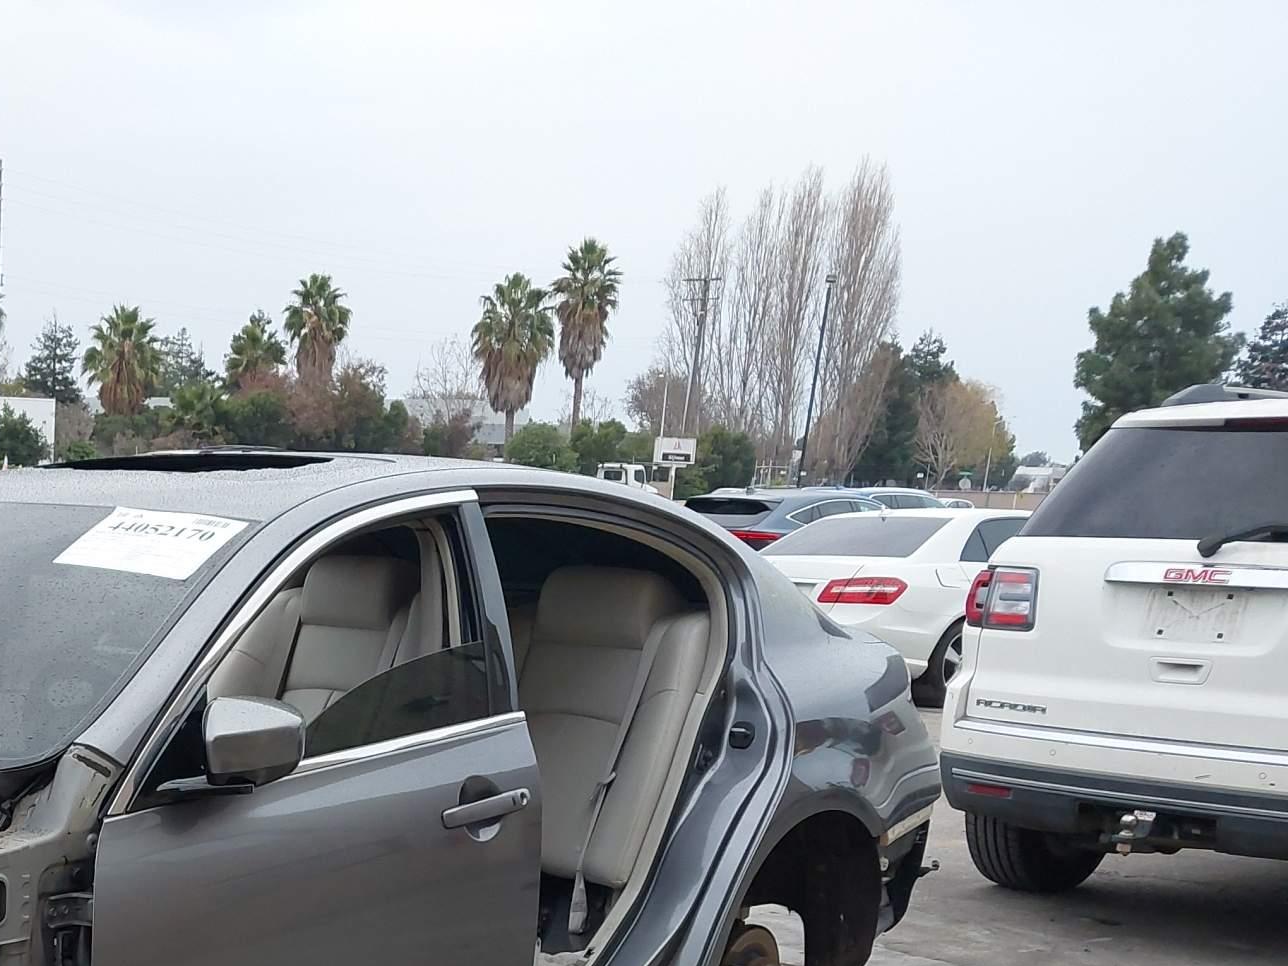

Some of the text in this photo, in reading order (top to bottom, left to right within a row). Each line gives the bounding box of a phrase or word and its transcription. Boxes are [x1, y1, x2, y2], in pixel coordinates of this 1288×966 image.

[108, 521, 215, 541] 44052170
[1163, 568, 1232, 584] GMC
[975, 698, 1047, 714] ACADIA
